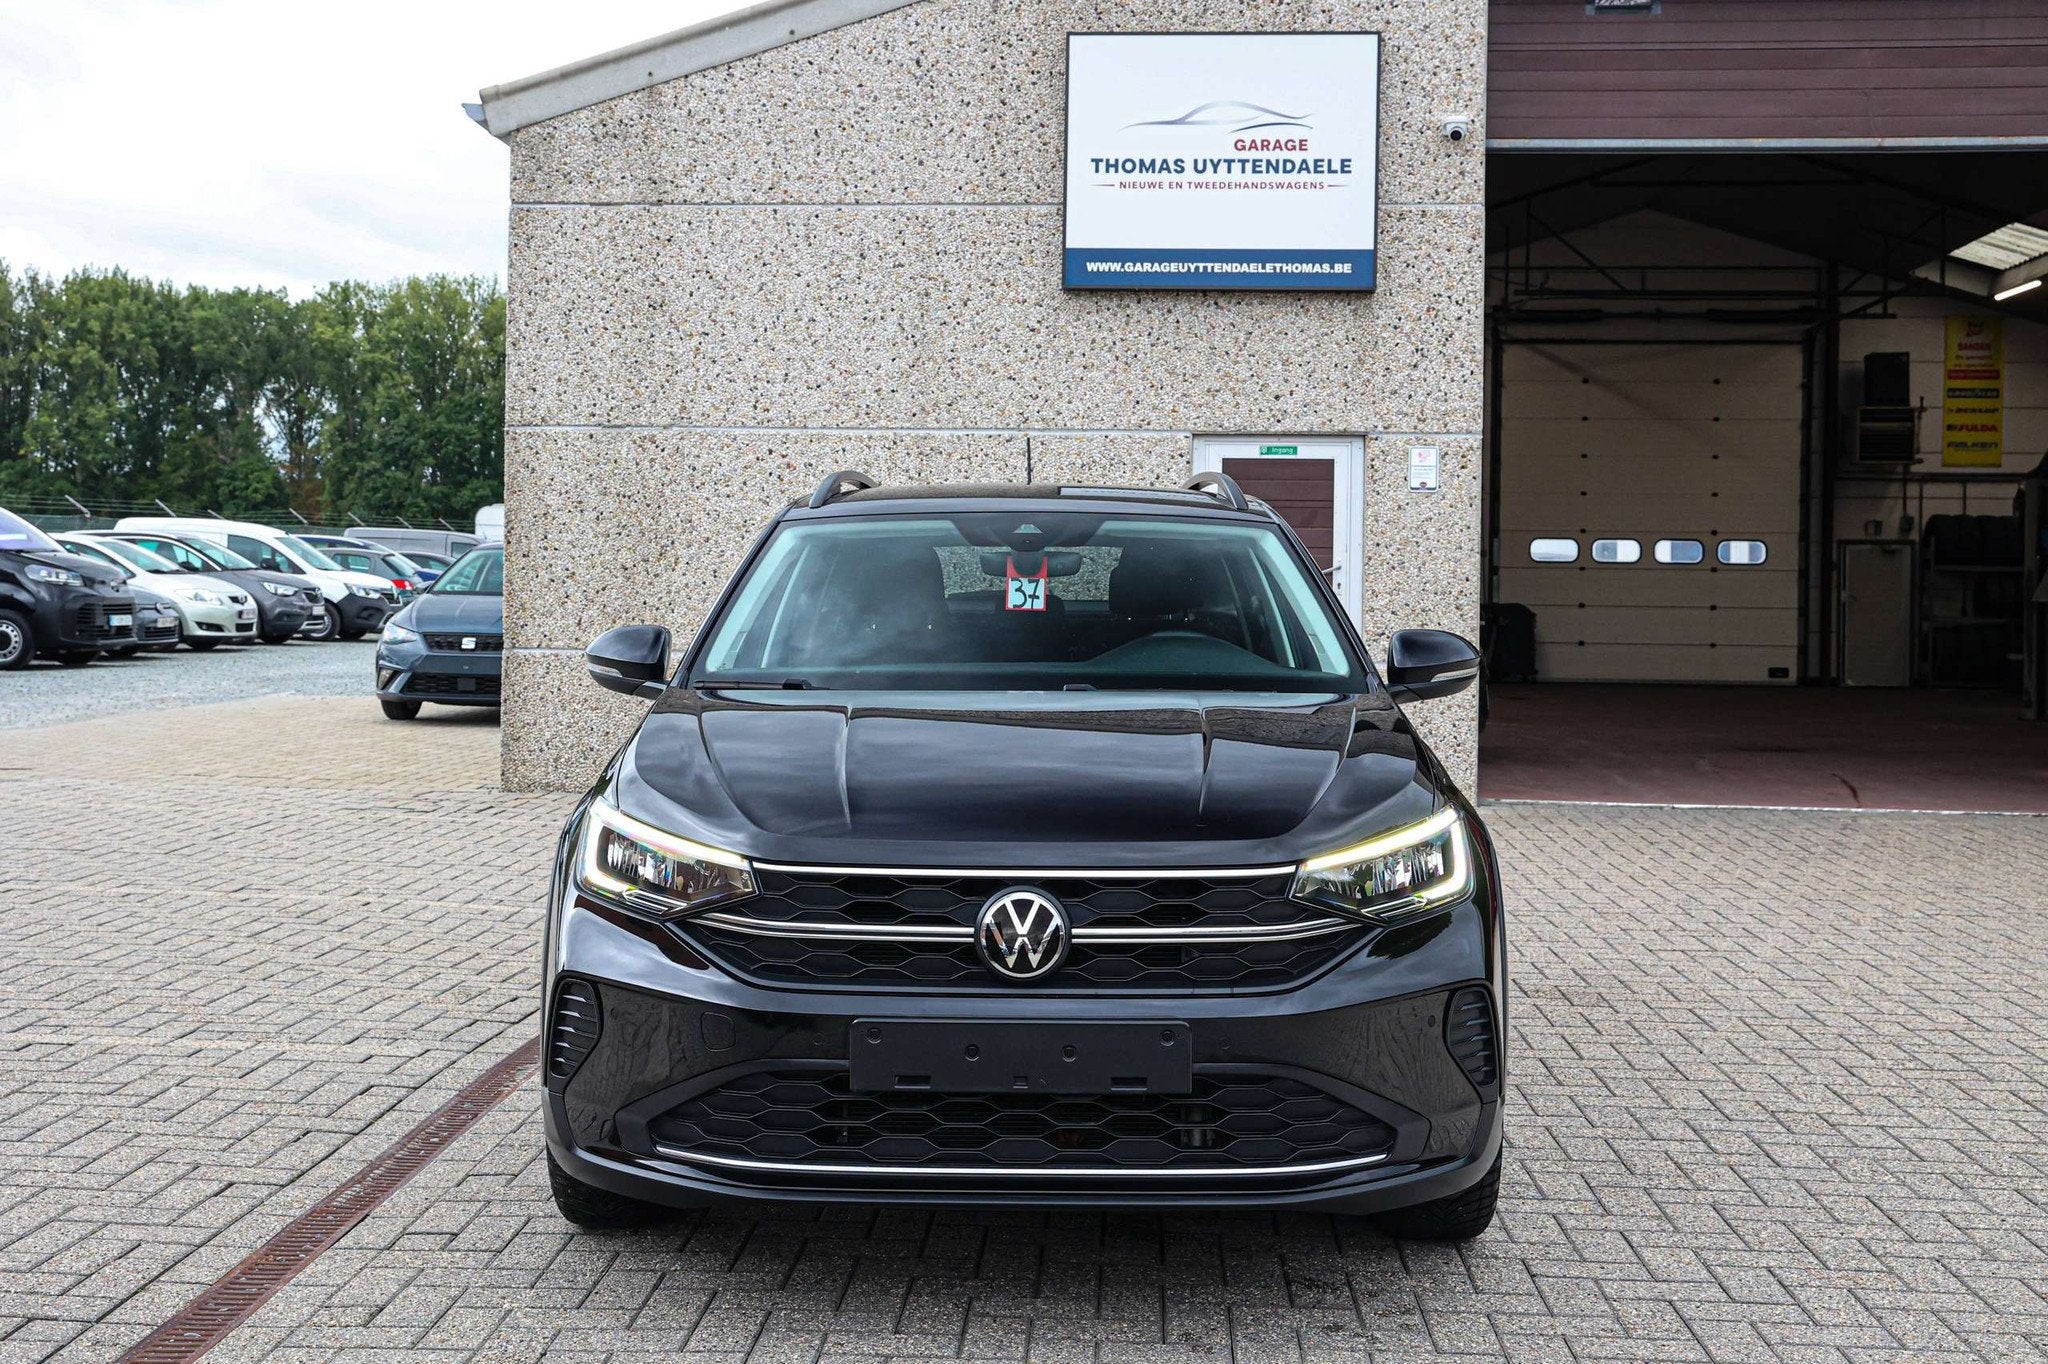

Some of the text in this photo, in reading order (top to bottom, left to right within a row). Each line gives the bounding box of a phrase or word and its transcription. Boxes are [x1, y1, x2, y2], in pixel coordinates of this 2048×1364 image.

[1234, 138, 1308, 151] GARAGE
[1091, 158, 1352, 174] THOMAS UYTTENDAELE
[1119, 181, 1325, 190] NIEUWE EN TWEEDEHANDSWAGENS
[1087, 261, 1352, 274] WWW.GARAGEUYTTENDAELETHOMAS.BE
[1011, 578, 1040, 609] 37
